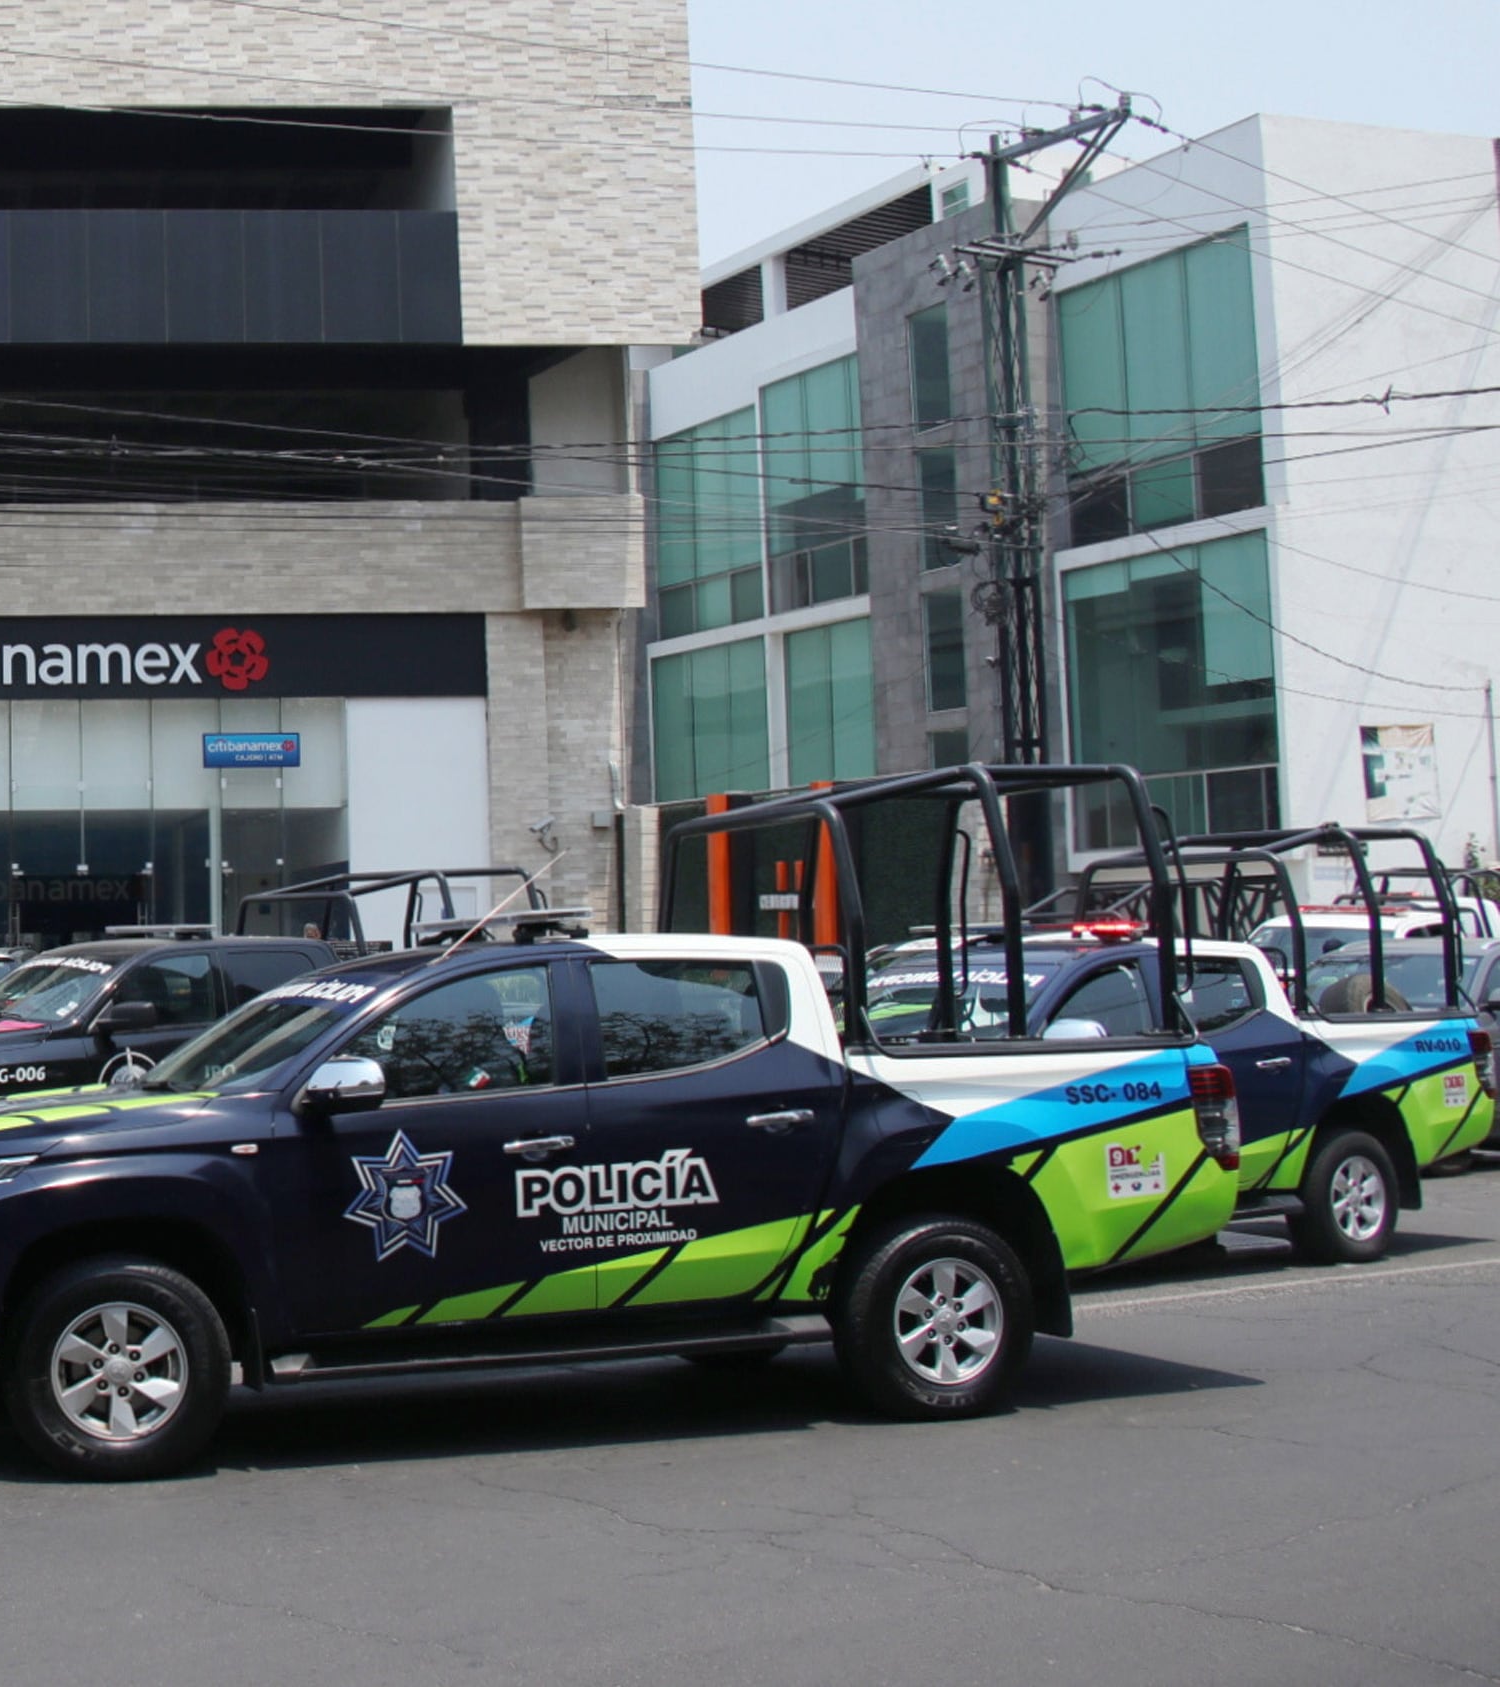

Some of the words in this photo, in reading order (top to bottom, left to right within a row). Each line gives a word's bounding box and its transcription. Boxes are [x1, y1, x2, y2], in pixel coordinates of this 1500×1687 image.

[207, 740, 282, 752] citibanamex
[1415, 1038, 1462, 1053] RV-010
[1122, 1081, 1162, 1102] 084
[515, 1148, 720, 1218] POLICÍA
[562, 1208, 673, 1235] MUNICIPAL
[540, 1236, 594, 1252] VECTOR
[596, 1234, 615, 1248] DE
[617, 1229, 697, 1246] PROXIMIDAD
